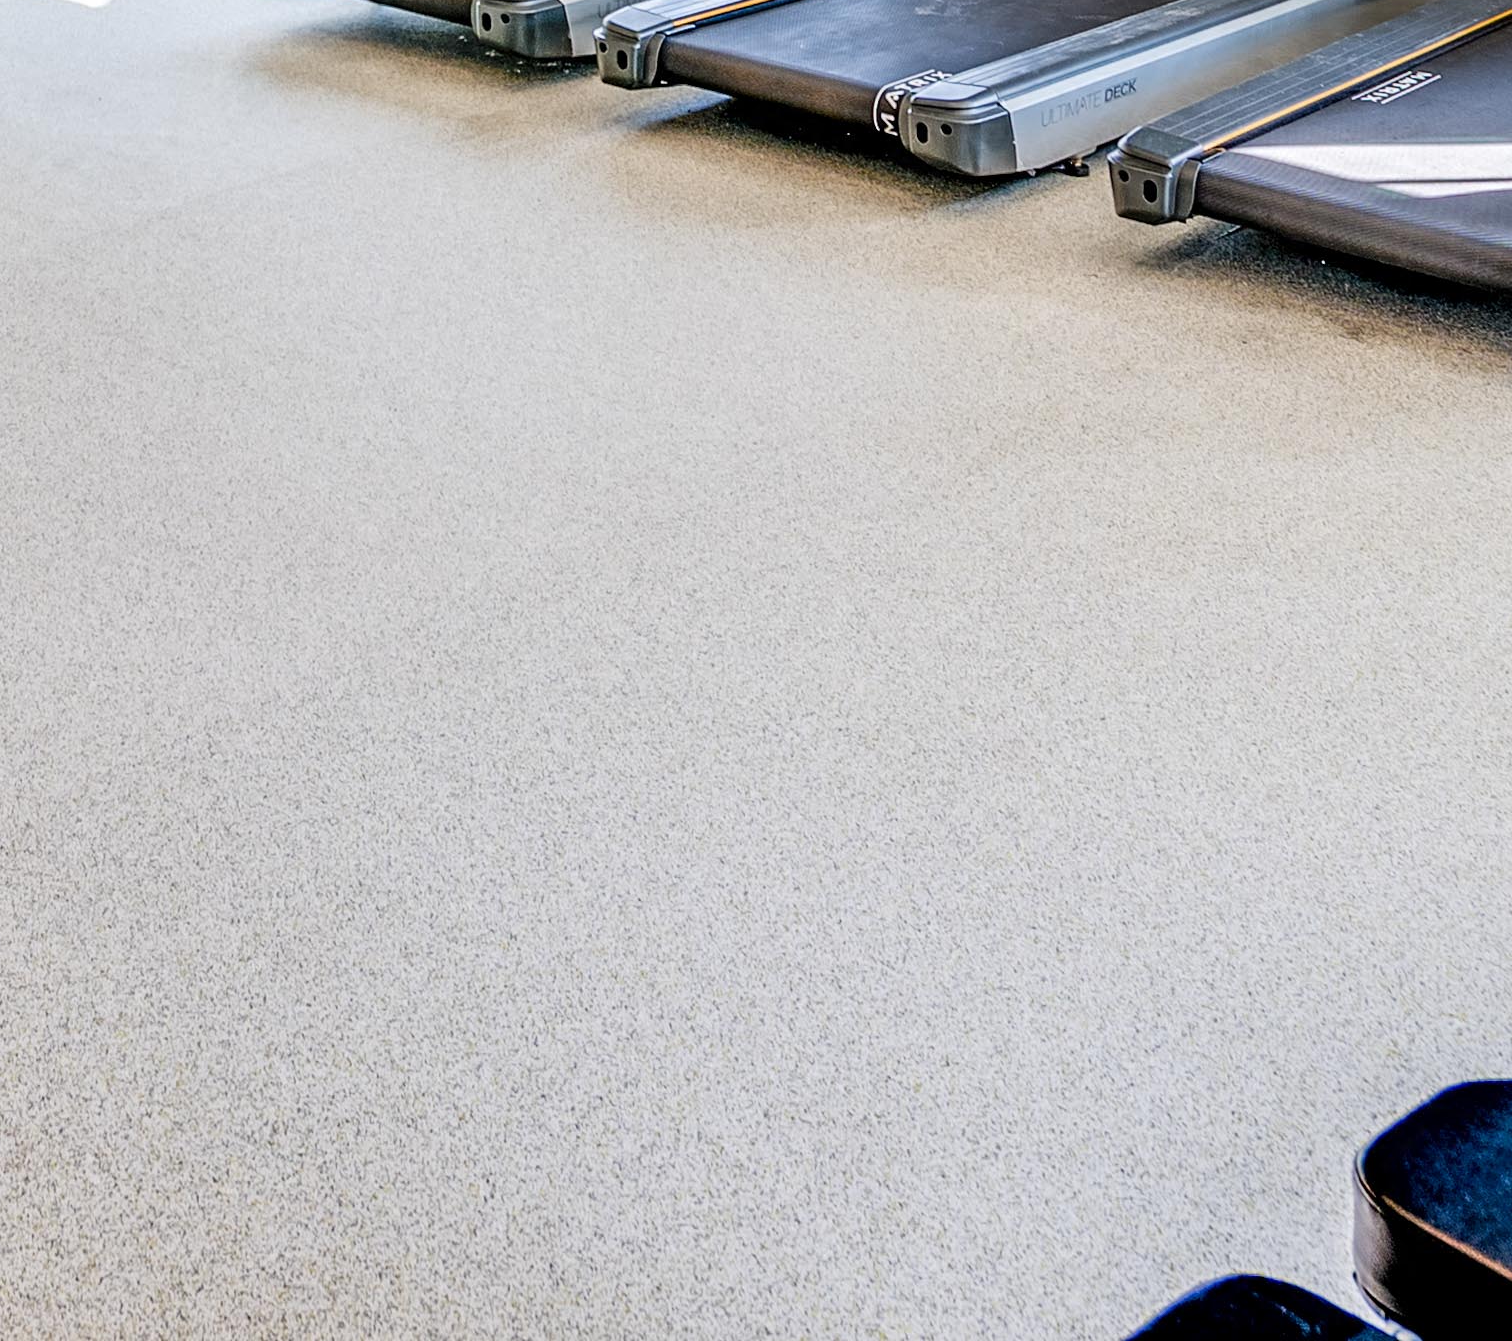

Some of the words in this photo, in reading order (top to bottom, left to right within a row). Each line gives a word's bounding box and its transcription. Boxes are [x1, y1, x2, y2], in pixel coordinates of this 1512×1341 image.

[878, 69, 953, 136] MATRIX
[1040, 90, 1102, 128] ULTIMATE
[1104, 77, 1138, 104] DECK
